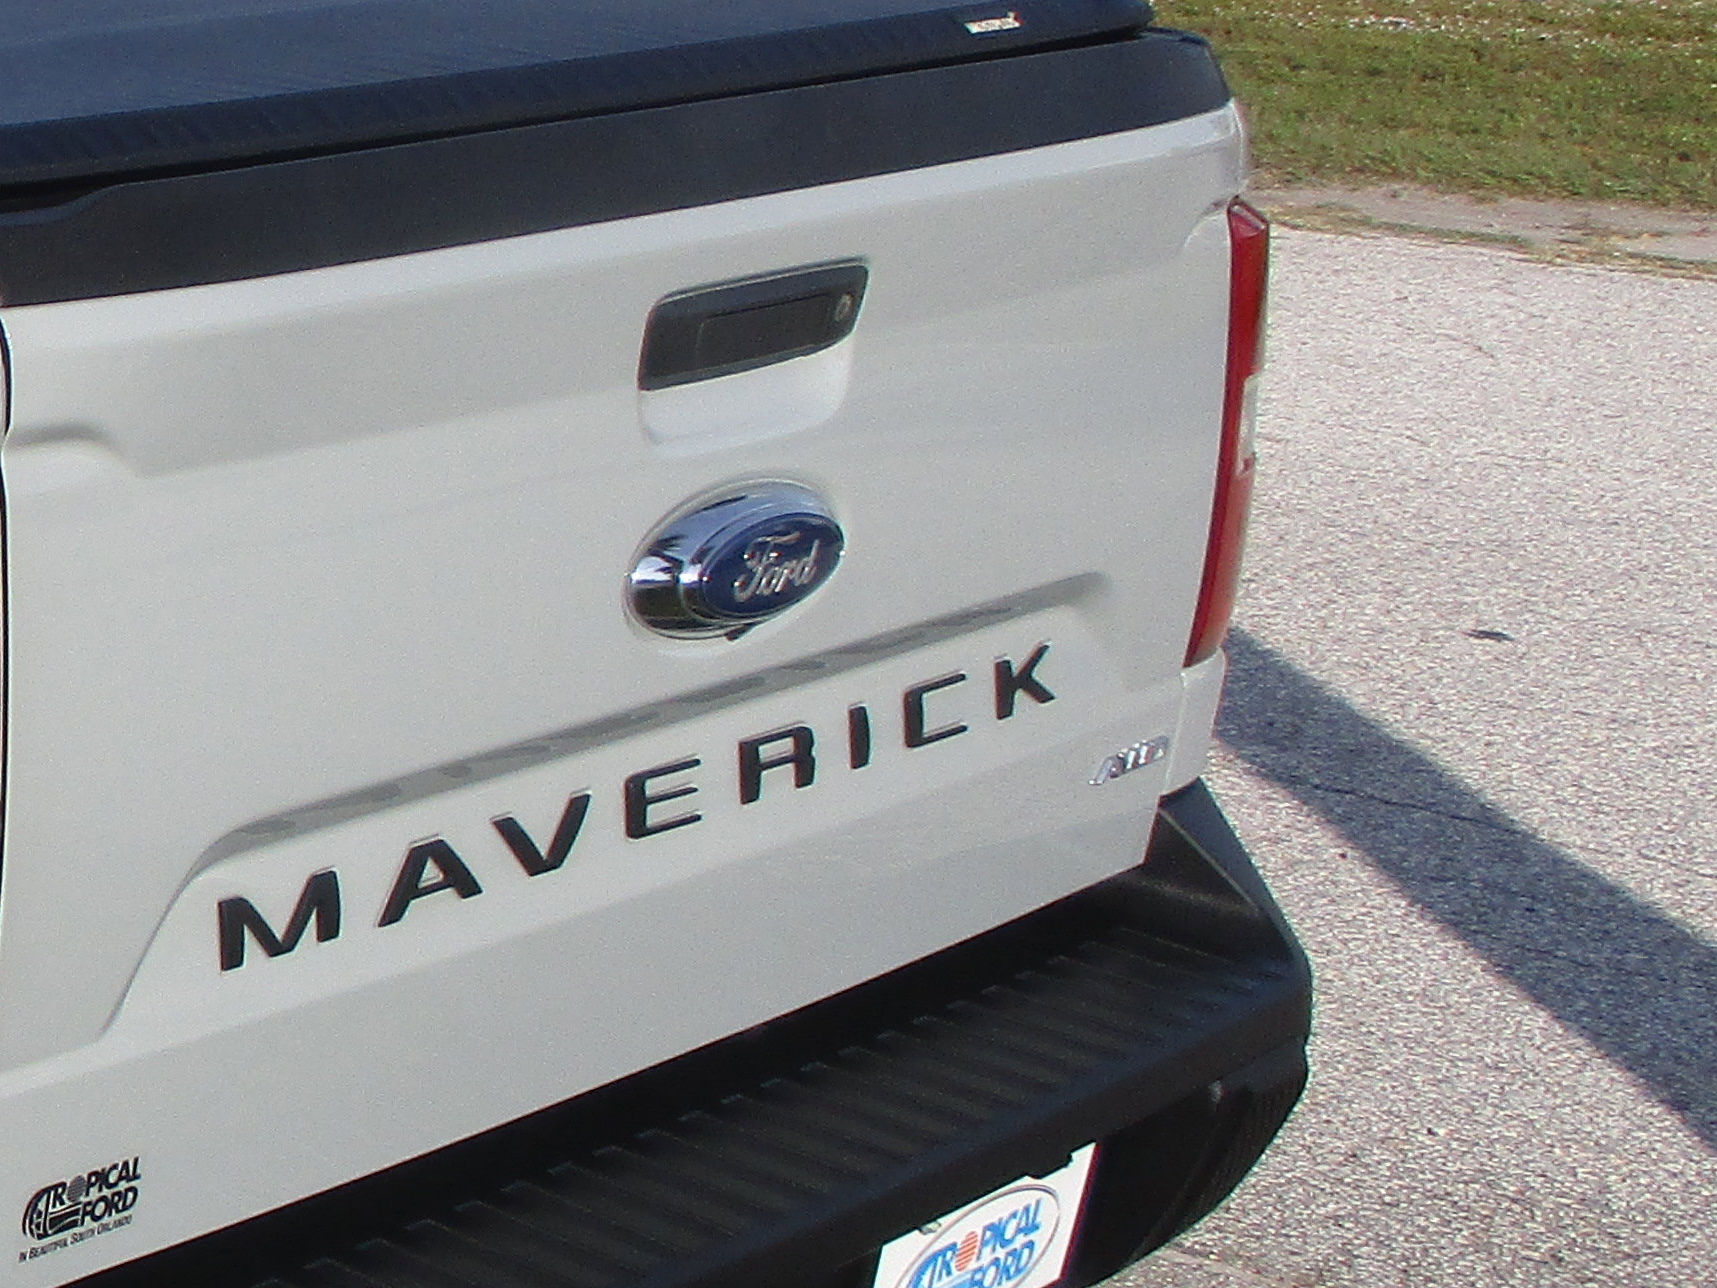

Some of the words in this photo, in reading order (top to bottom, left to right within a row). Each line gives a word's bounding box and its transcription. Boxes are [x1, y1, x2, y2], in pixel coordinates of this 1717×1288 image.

[732, 531, 820, 602] Ford
[217, 638, 1057, 972] MAVERICK
[79, 1185, 138, 1227] FORD
